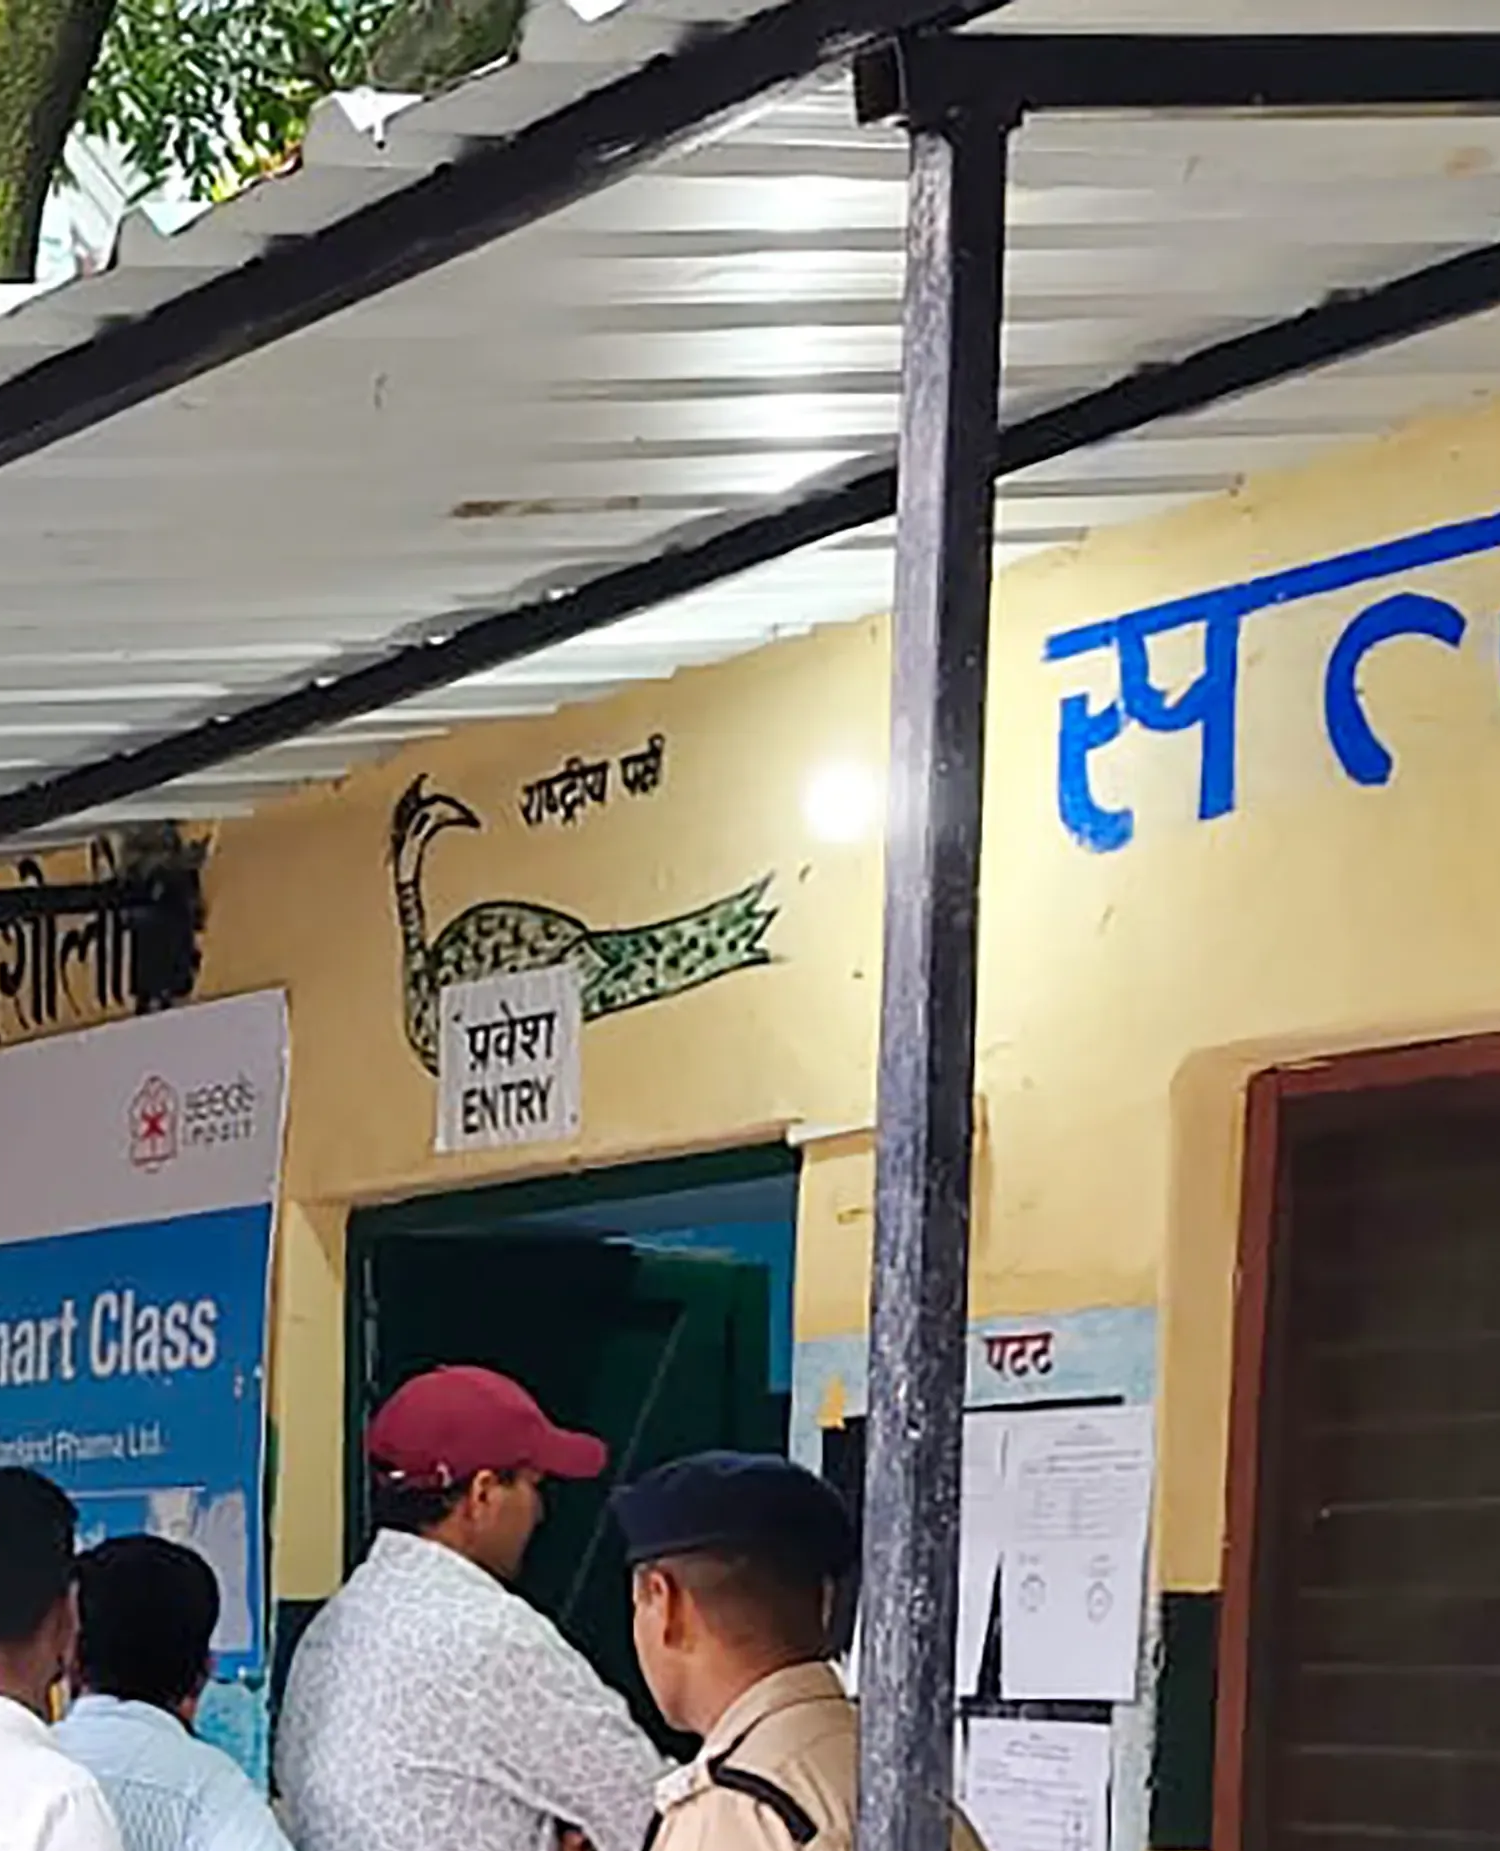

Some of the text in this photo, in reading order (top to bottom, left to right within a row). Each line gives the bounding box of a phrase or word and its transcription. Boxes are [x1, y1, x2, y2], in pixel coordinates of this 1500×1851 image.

[465, 1002, 557, 1073] प्रवेश
[461, 1076, 555, 1136] ENTRY
[89, 1287, 218, 1379] Class
